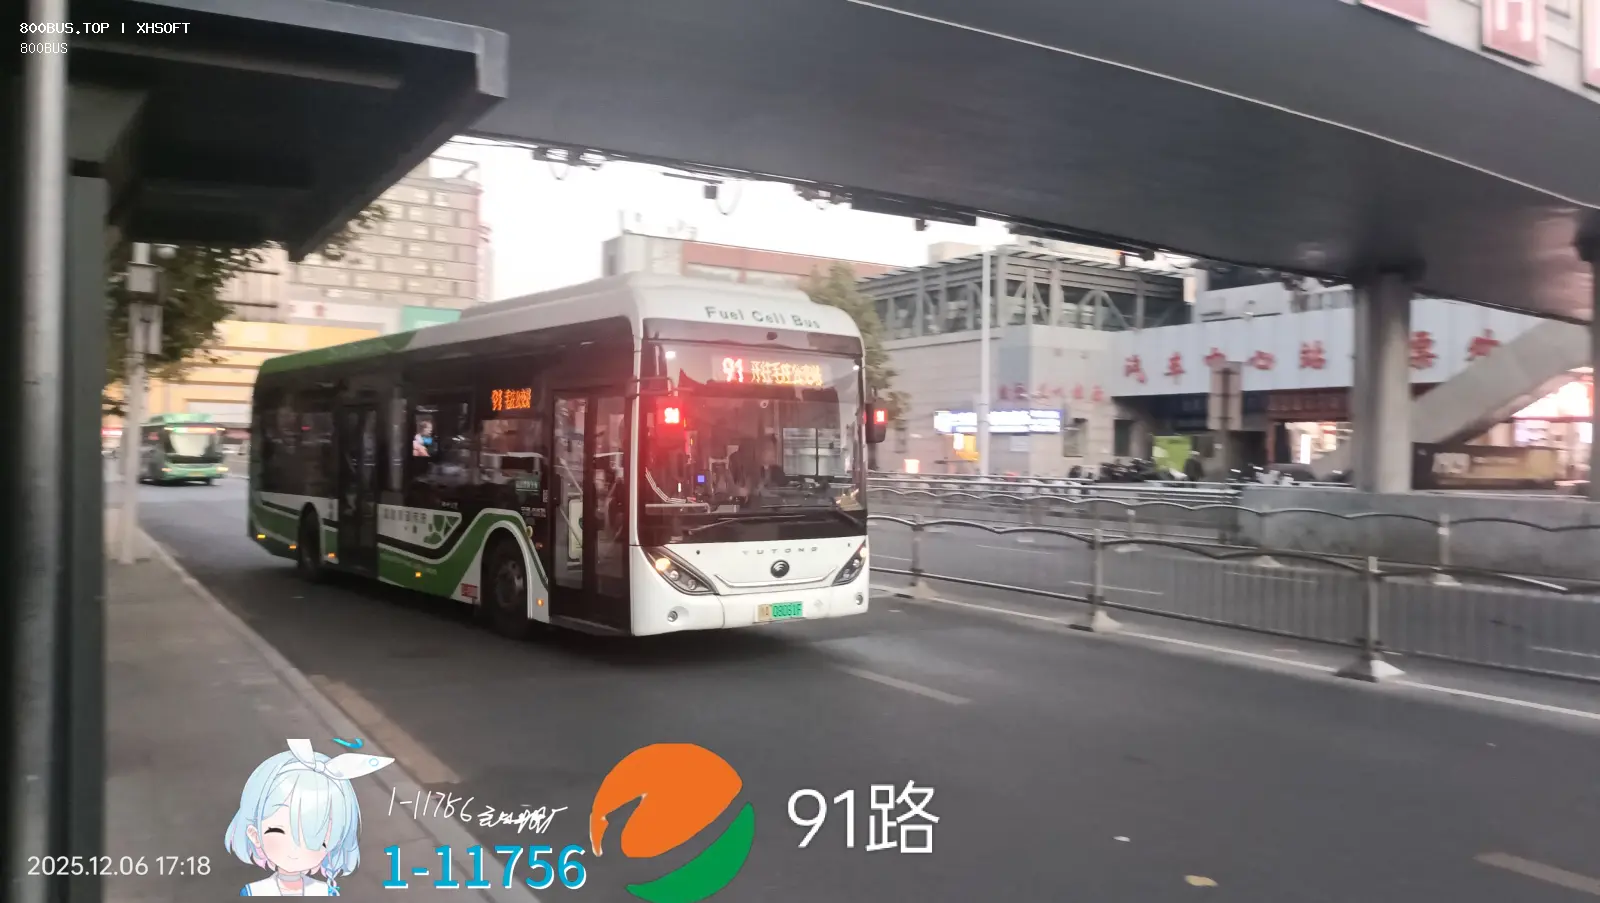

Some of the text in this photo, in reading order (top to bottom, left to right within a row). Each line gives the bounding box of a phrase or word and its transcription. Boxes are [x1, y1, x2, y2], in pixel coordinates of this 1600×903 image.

[704, 306, 821, 329] Fuel Cell Bus
[721, 357, 744, 383] 91
[491, 389, 503, 411] 91
[741, 546, 818, 555] YUTONG
